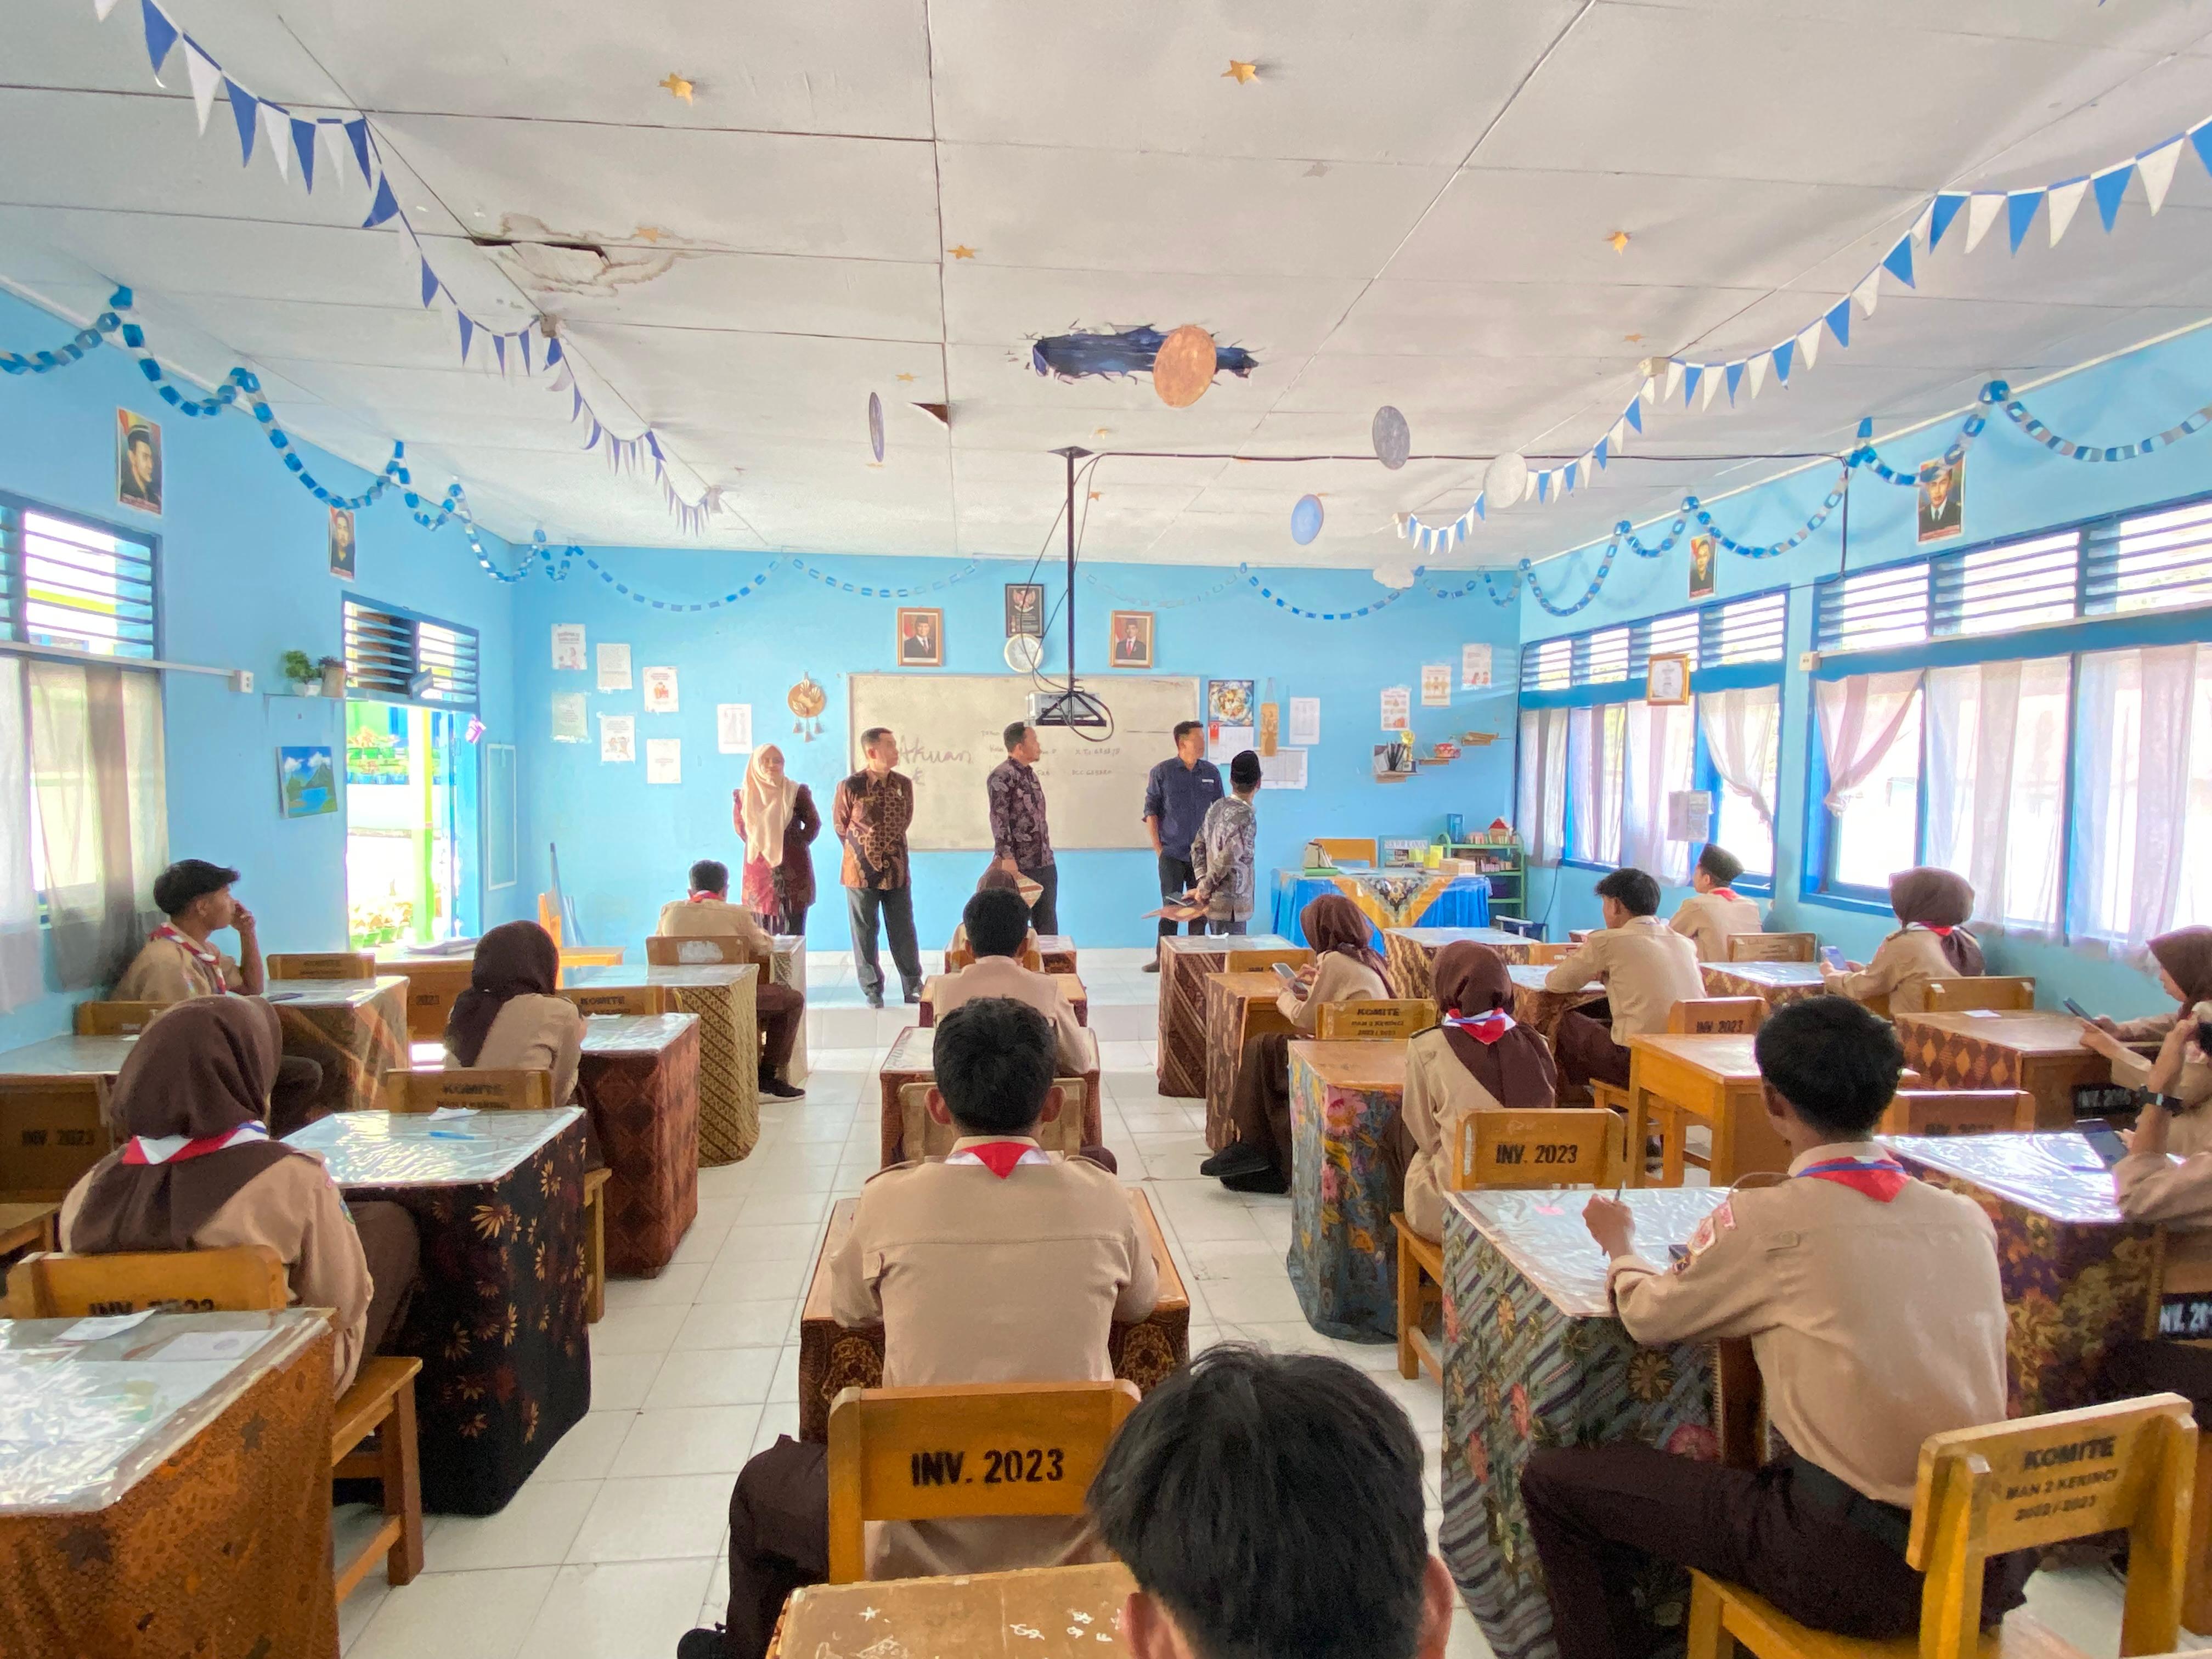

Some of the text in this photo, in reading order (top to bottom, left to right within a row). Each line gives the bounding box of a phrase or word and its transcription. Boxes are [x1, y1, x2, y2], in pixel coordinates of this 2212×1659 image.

[1357, 1008, 1400, 1016] KOMITE
[1496, 1144, 1578, 1164] INV. 2023
[2021, 1435, 2118, 1471] KOMITE
[911, 1448, 1065, 1487] INV. 2023
